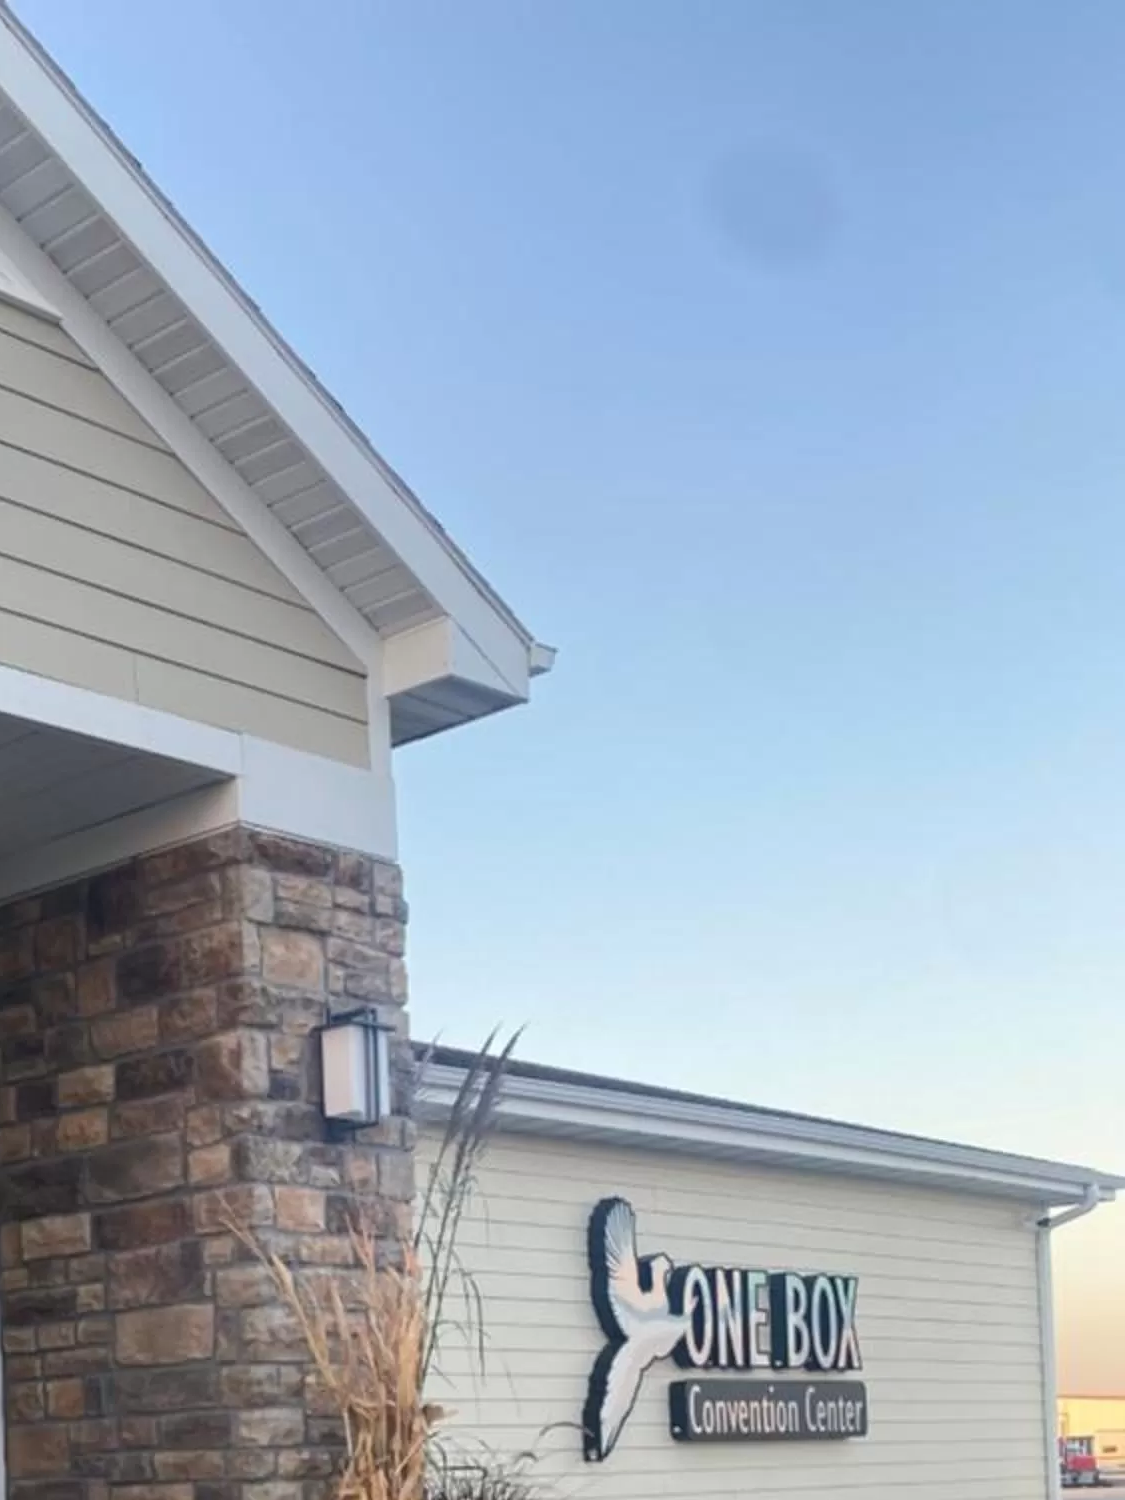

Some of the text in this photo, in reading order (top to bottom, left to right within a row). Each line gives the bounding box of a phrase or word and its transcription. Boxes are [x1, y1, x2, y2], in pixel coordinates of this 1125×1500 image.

[683, 1265, 861, 1369] ONE BOX
[688, 1384, 864, 1434] Convention Center
